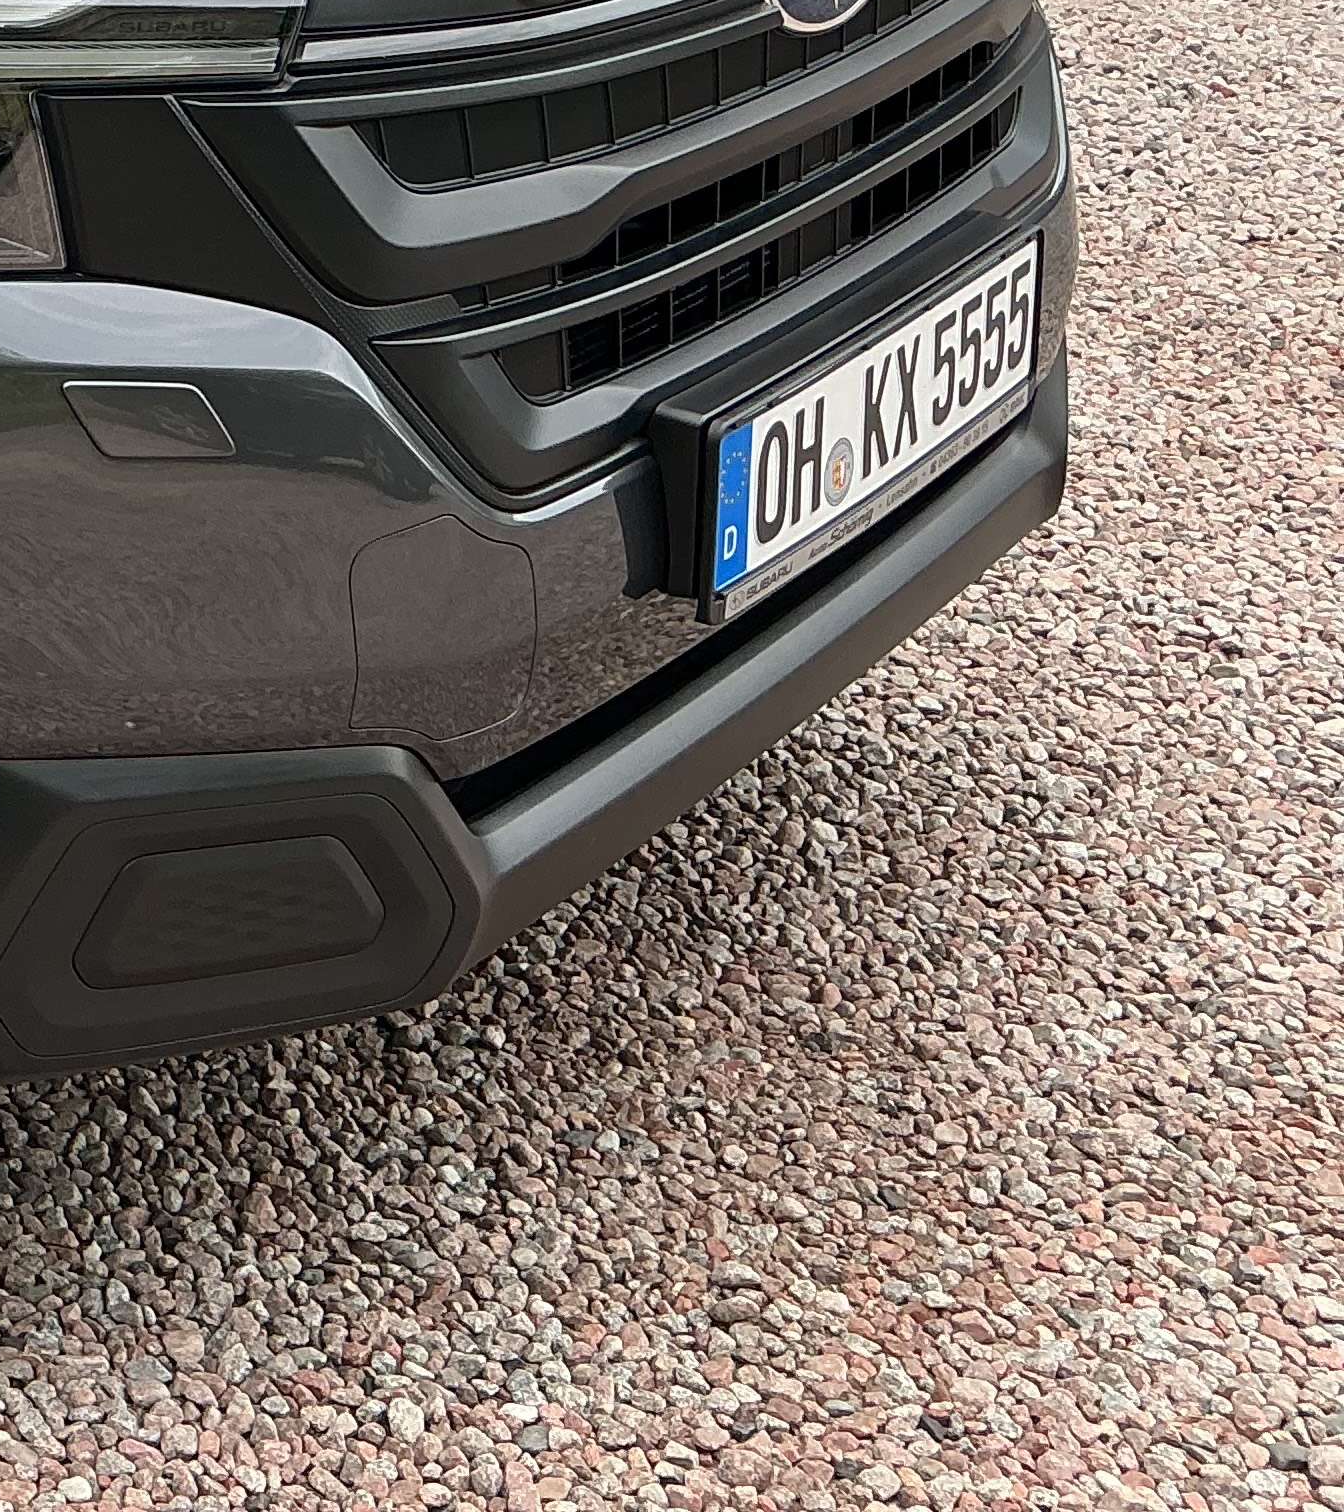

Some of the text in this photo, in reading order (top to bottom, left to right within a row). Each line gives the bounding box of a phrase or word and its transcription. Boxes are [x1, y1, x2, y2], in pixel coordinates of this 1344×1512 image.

[755, 258, 1033, 545] OH KX 5555
[722, 525, 738, 561] D
[746, 561, 793, 600] SUBARU
